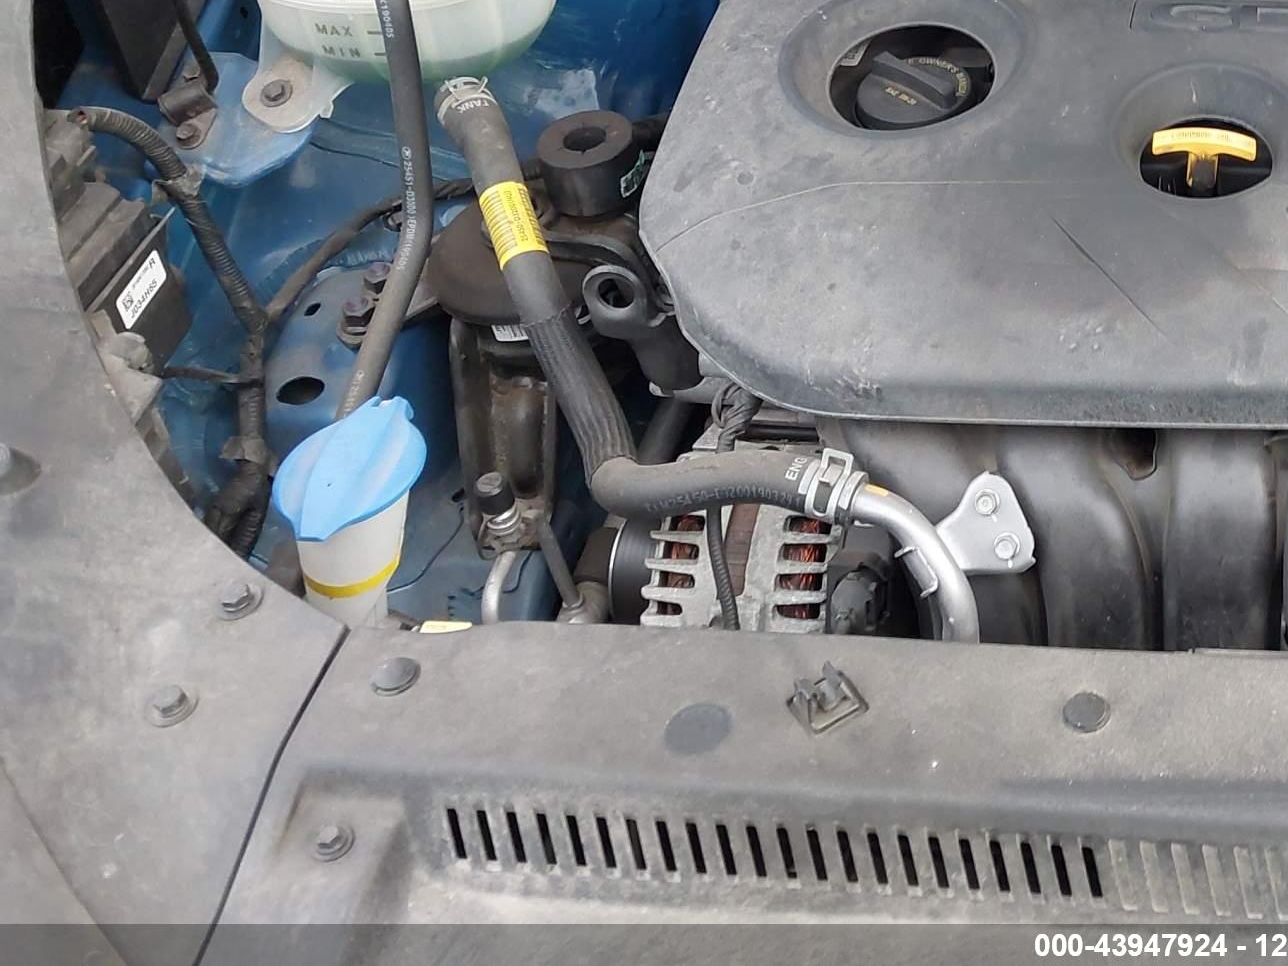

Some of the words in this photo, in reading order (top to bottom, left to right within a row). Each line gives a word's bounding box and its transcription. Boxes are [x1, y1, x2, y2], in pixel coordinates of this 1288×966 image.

[314, 22, 353, 37] MAX
[321, 44, 361, 58] MIN
[457, 99, 489, 114] TANK
[784, 456, 808, 482] ENG
